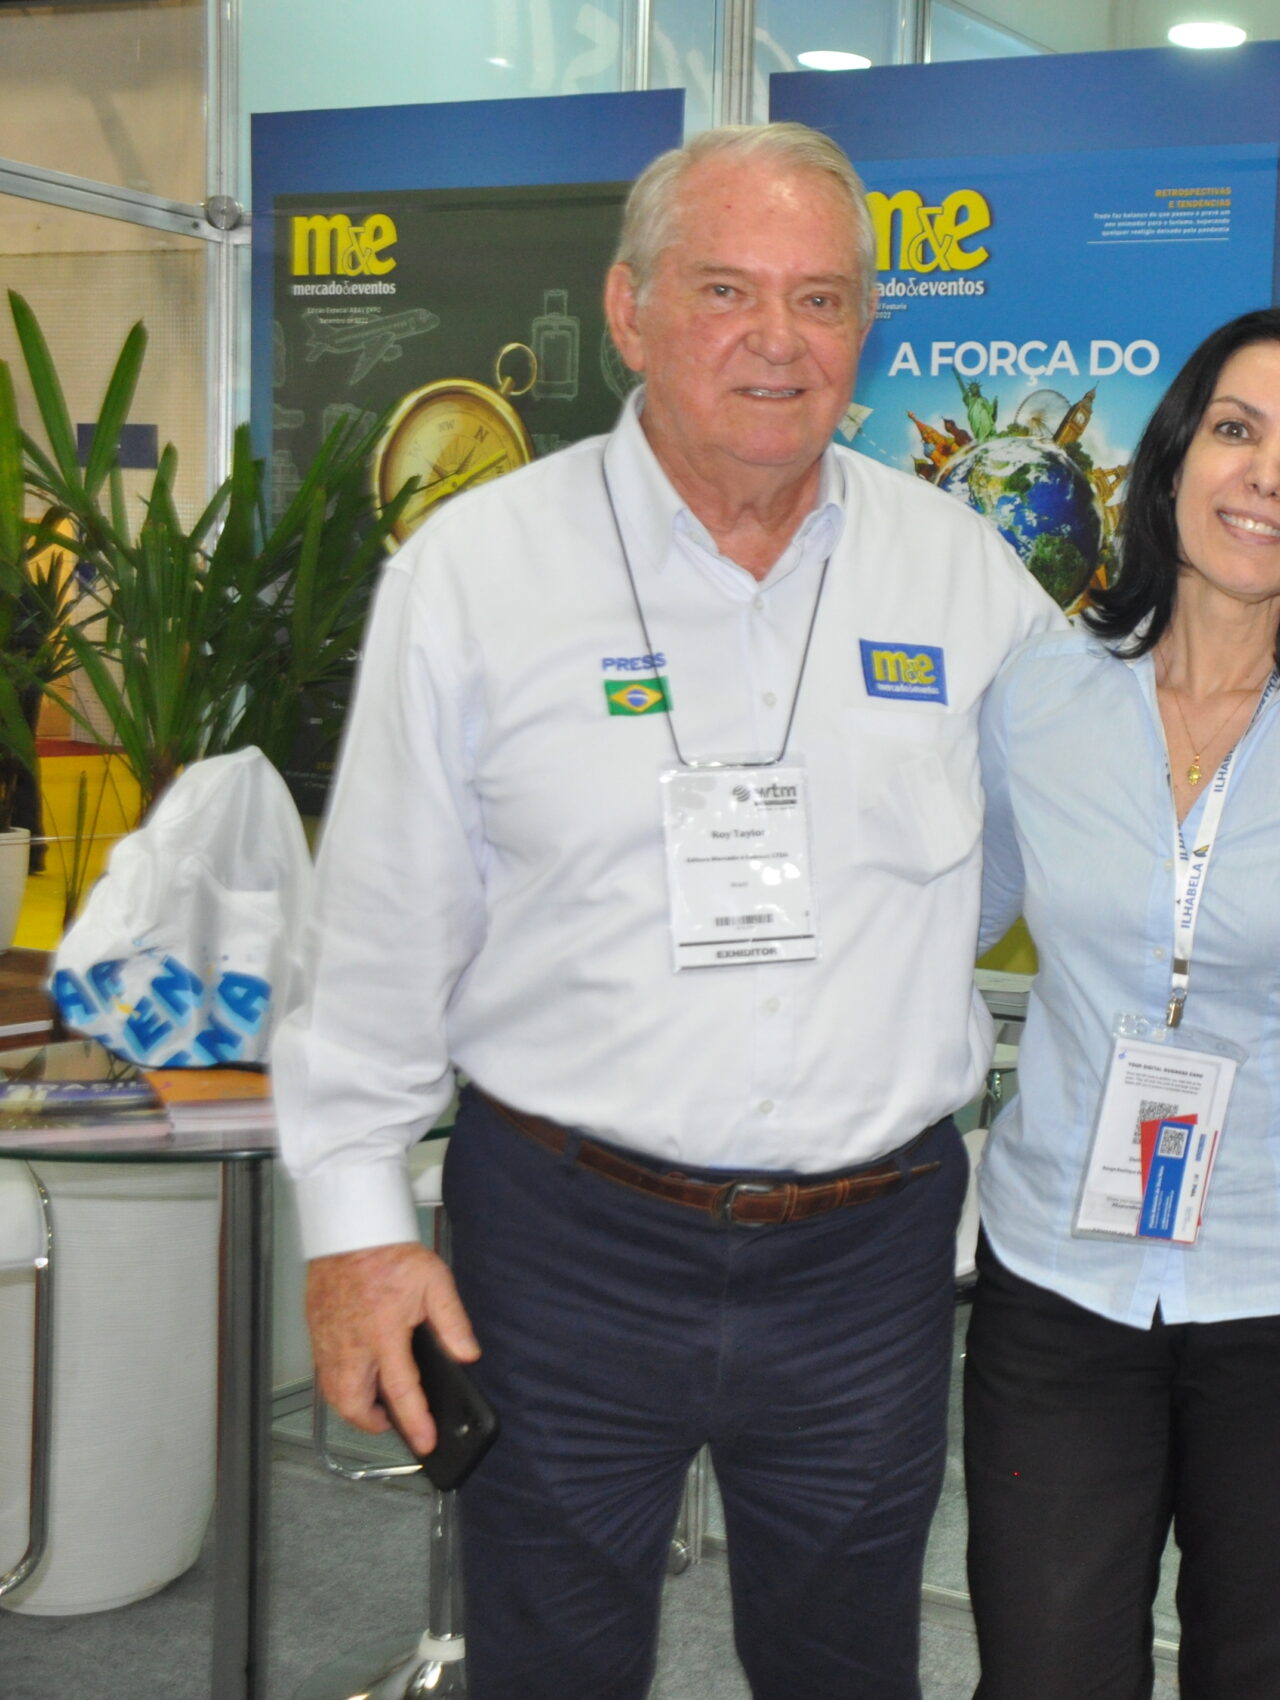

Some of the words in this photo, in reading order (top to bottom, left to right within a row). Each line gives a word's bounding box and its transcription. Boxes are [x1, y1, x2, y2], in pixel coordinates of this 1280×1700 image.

[292, 213, 398, 276] m&e
[292, 281, 397, 296] mercado&eventos
[878, 277, 985, 297] ado&eventos
[888, 341, 922, 376] A
[930, 340, 1081, 387] FORÇA
[1089, 339, 1161, 377] DO
[601, 652, 667, 672] PRESS
[1181, 863, 1203, 928] ILHABELA
